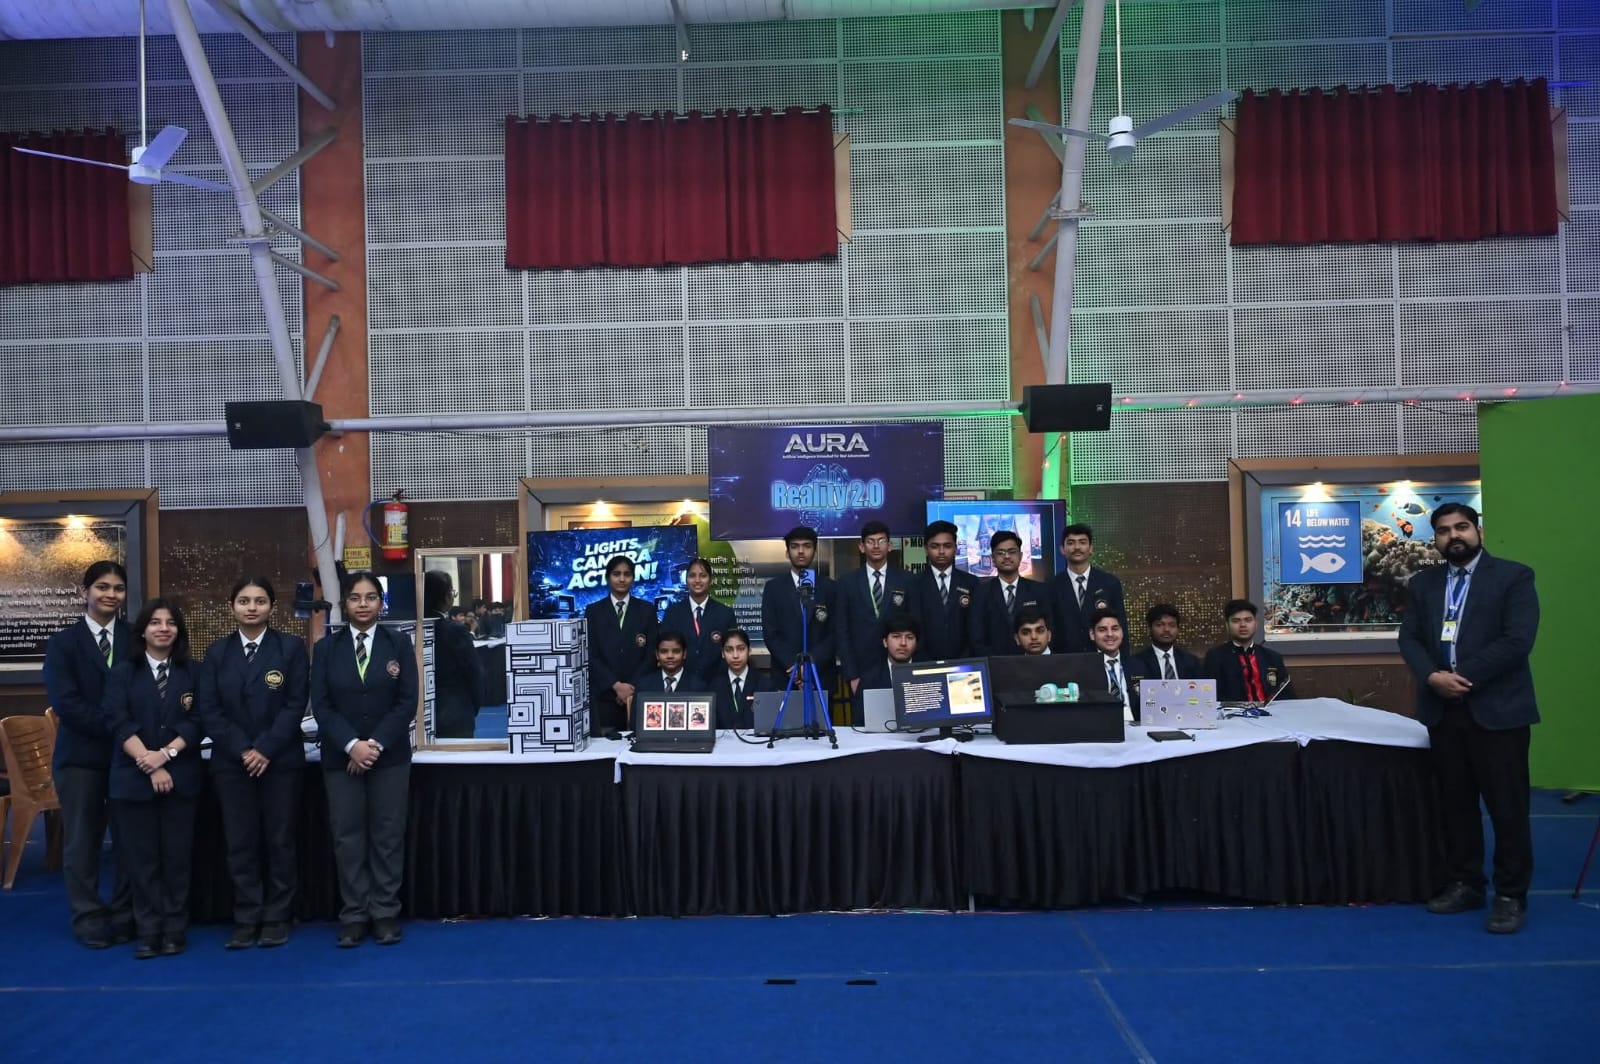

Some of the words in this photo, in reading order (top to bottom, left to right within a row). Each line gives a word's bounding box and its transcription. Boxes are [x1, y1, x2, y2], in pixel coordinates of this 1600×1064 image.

[784, 432, 870, 453] AURA
[773, 481, 848, 511] Reality
[850, 479, 884, 508] 2.0
[1285, 508, 1302, 528] 14
[1306, 508, 1319, 517] LIFE
[1306, 518, 1329, 527] BELOW
[1329, 517, 1350, 527] WATER
[572, 548, 652, 572] CAMRA
[567, 561, 659, 590] ACTN!
[733, 602, 762, 610] transpor
[0, 641, 37, 649] sponsibility.
